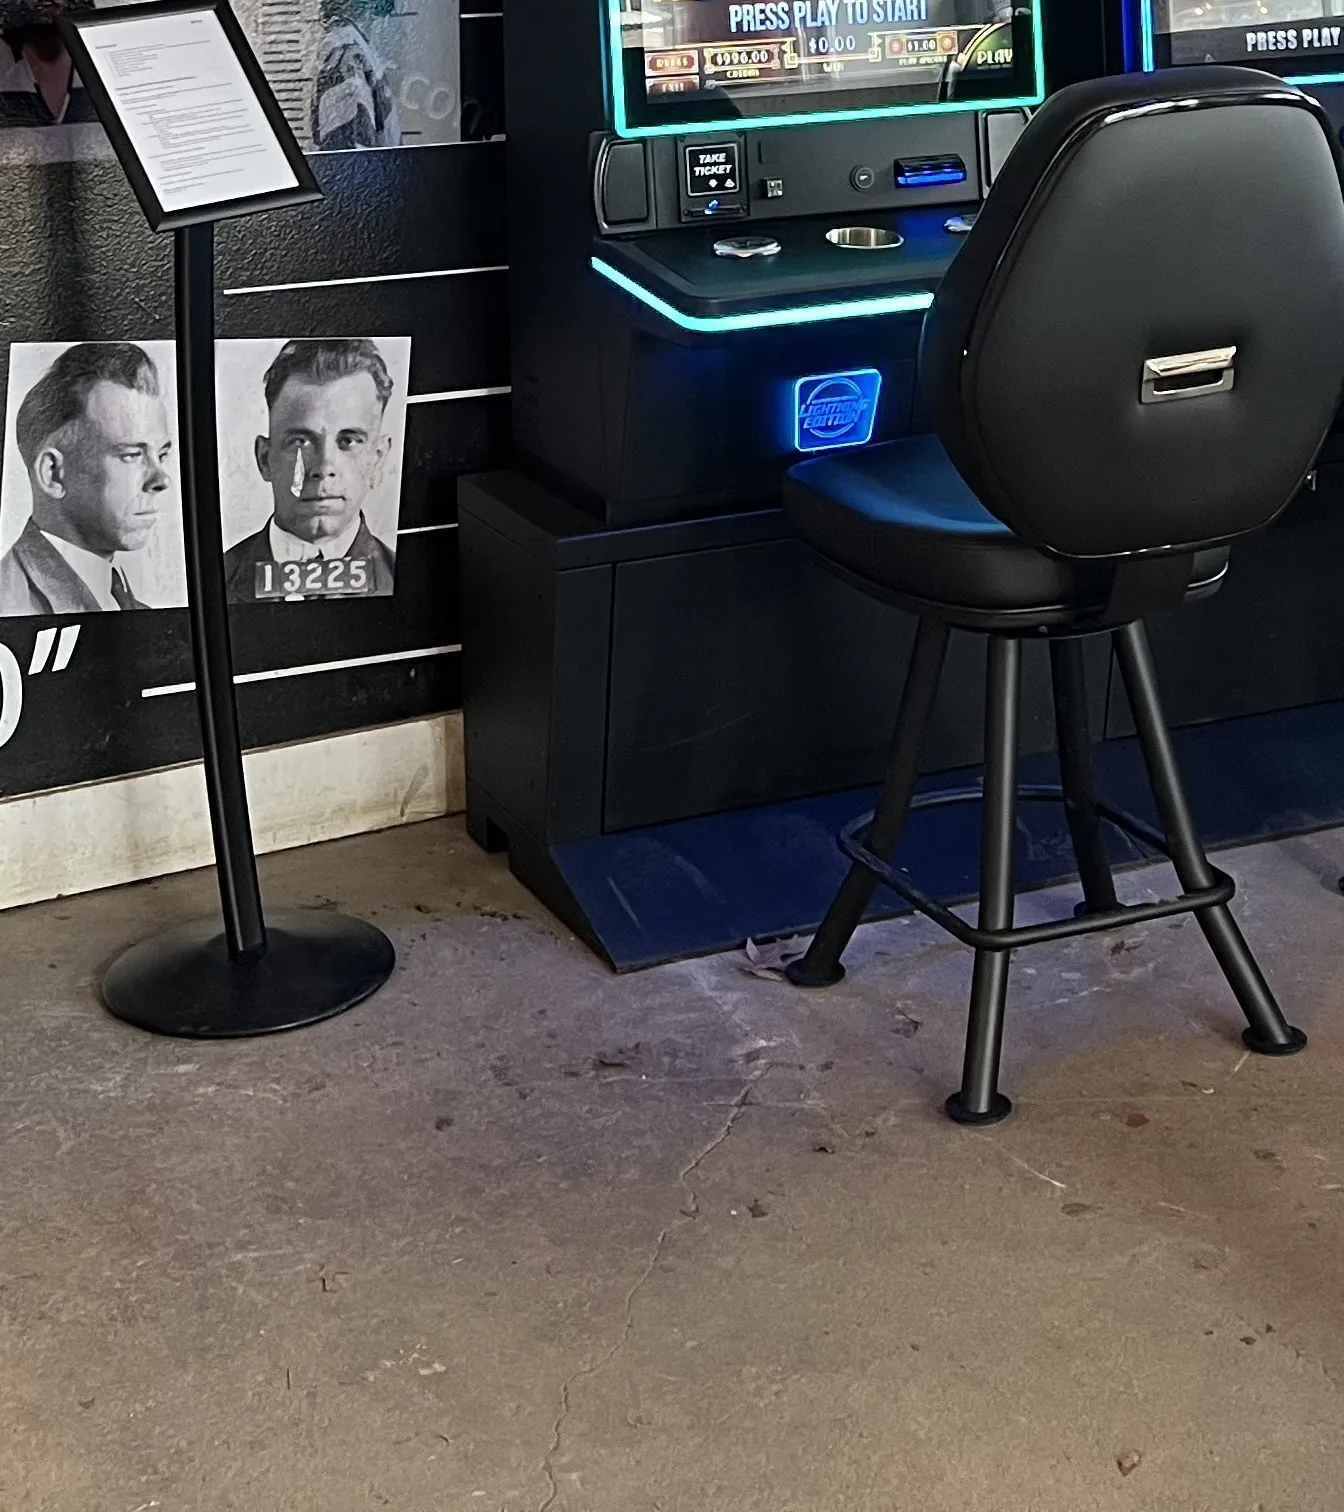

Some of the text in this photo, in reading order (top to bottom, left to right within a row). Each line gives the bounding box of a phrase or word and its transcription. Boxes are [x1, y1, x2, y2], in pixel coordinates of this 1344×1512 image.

[728, 1, 789, 33] PRESS
[793, 0, 839, 29] PLAY
[1245, 28, 1298, 52] PRESS
[1302, 26, 1341, 49] PLAY
[716, 36, 936, 66] $996.00 $0.00 $1.00
[976, 48, 1013, 66] PLAY
[699, 153, 726, 164] TAKE
[694, 165, 732, 176] TICKET
[798, 399, 871, 417] LIGHTNING
[803, 410, 859, 428] EDITION
[259, 561, 369, 594] 13225
